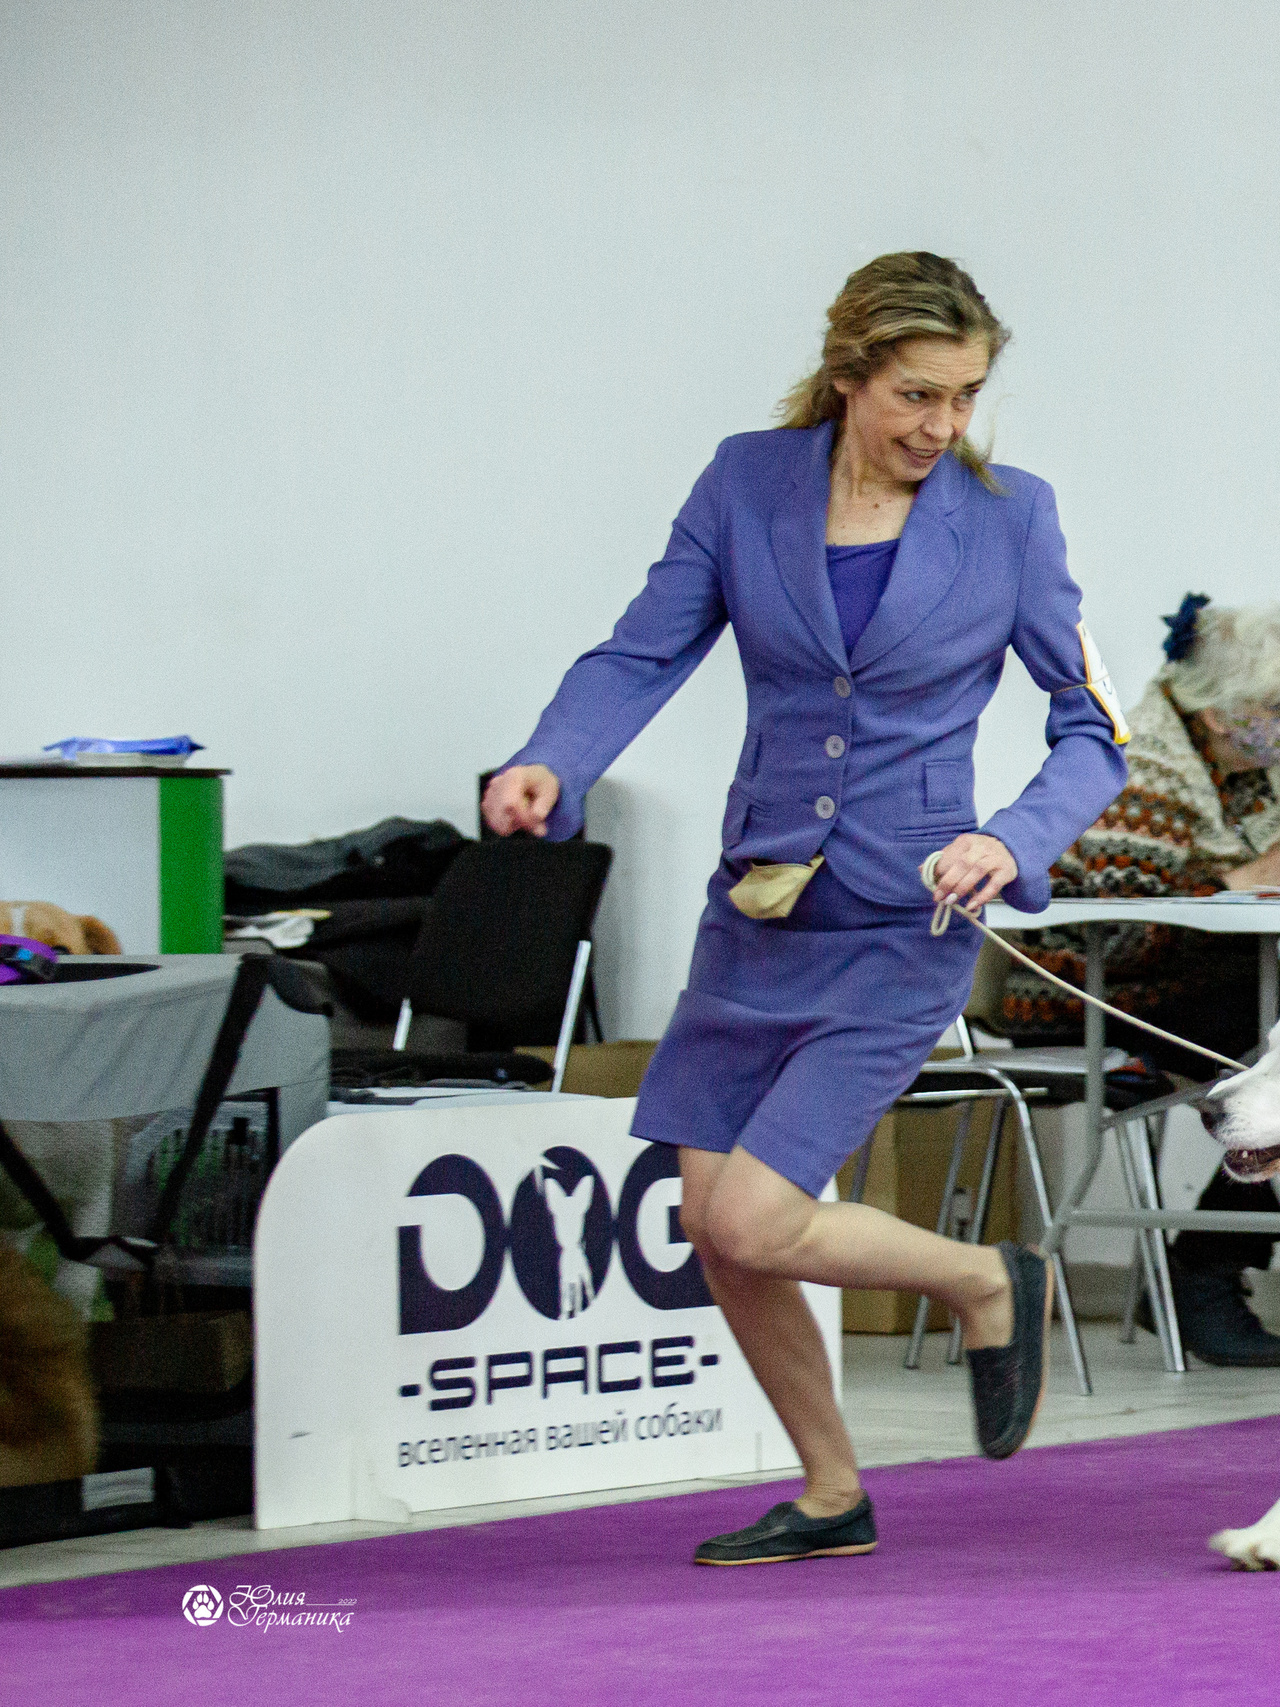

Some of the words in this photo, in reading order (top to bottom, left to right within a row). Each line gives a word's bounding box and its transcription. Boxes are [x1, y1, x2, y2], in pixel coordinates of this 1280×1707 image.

[397, 1142, 721, 1335] DOG
[398, 1427, 540, 1467] вселенная
[545, 1409, 629, 1451] вашей
[634, 1402, 723, 1441] собаки
